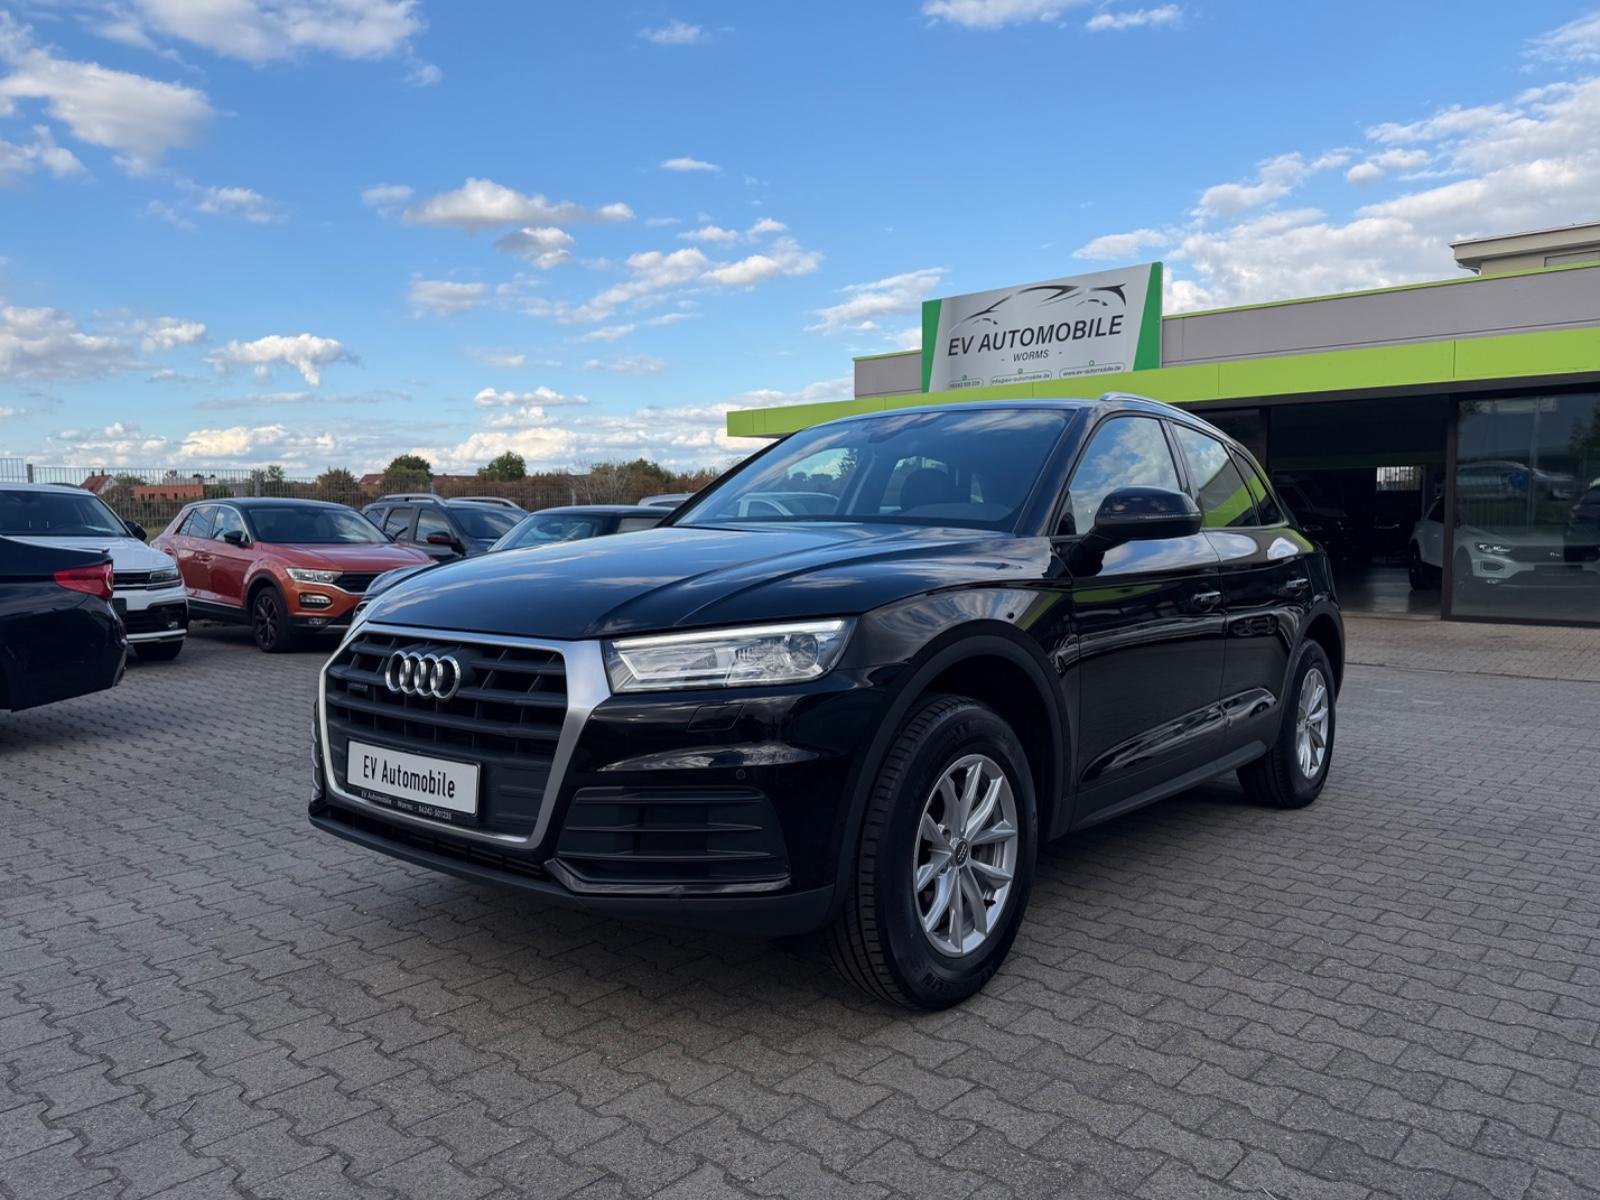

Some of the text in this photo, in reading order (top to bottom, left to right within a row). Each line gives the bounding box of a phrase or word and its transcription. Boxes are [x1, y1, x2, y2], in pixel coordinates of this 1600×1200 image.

[948, 314, 1125, 357] EV AUTOMOBILE
[1013, 349, 1049, 362] WORMS
[363, 755, 455, 799] EV Automobile
